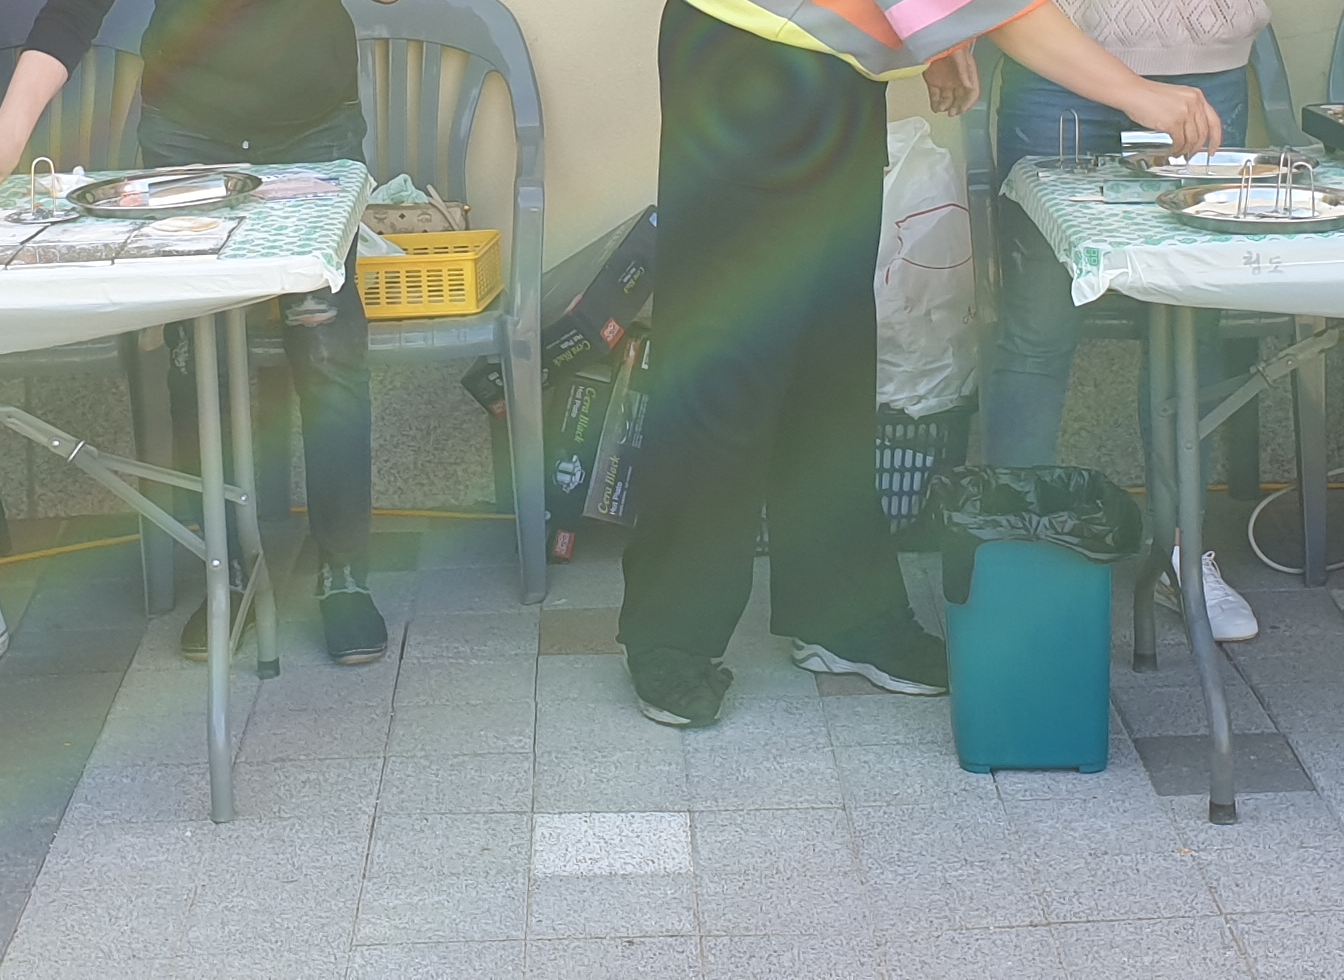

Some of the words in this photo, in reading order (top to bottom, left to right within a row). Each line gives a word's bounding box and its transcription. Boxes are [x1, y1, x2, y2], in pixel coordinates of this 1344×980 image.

[581, 387, 596, 417] Cera
[574, 415, 590, 444] Black
[598, 486, 612, 515] Cera
[606, 455, 620, 487] Black
